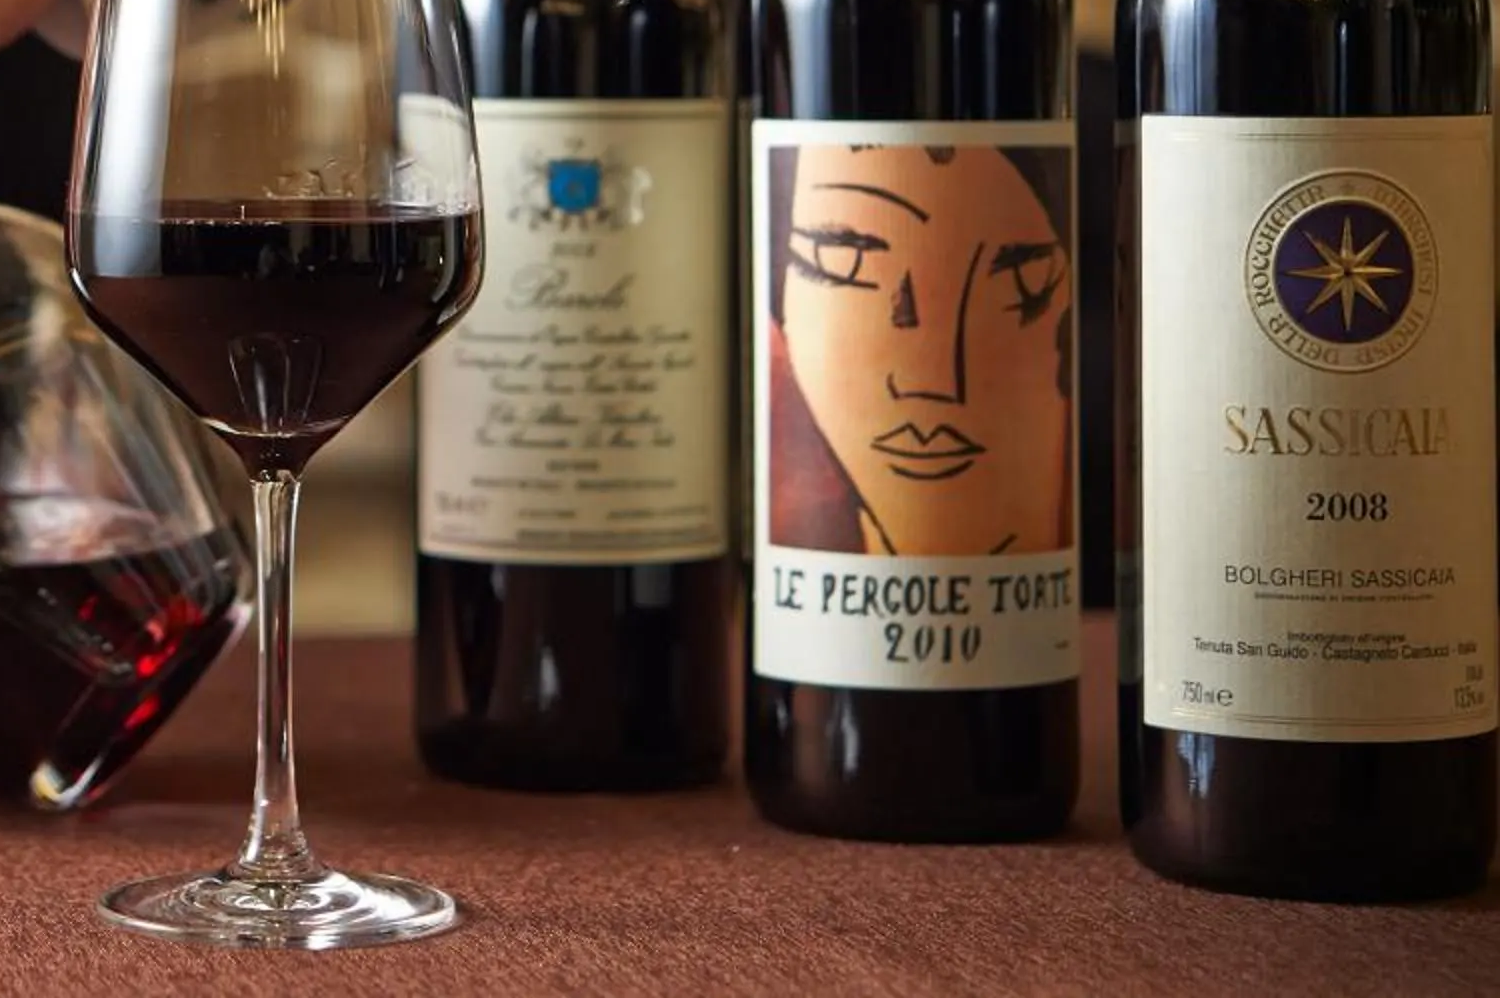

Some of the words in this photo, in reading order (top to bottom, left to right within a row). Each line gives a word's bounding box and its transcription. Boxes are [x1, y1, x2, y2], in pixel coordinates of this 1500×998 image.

[1223, 404, 1452, 457] SASSICAIA
[1306, 492, 1388, 522] 2008
[774, 566, 805, 610] LE
[821, 573, 972, 618] PERGOLE
[987, 568, 1073, 614] TORTE
[1224, 565, 1343, 588] BOLGHERI
[1350, 568, 1456, 588] SASSICAIA
[883, 622, 982, 662] 2010
[1193, 636, 1233, 655] Tenuta
[1237, 641, 1262, 657] San
[1267, 642, 1310, 659] Guido
